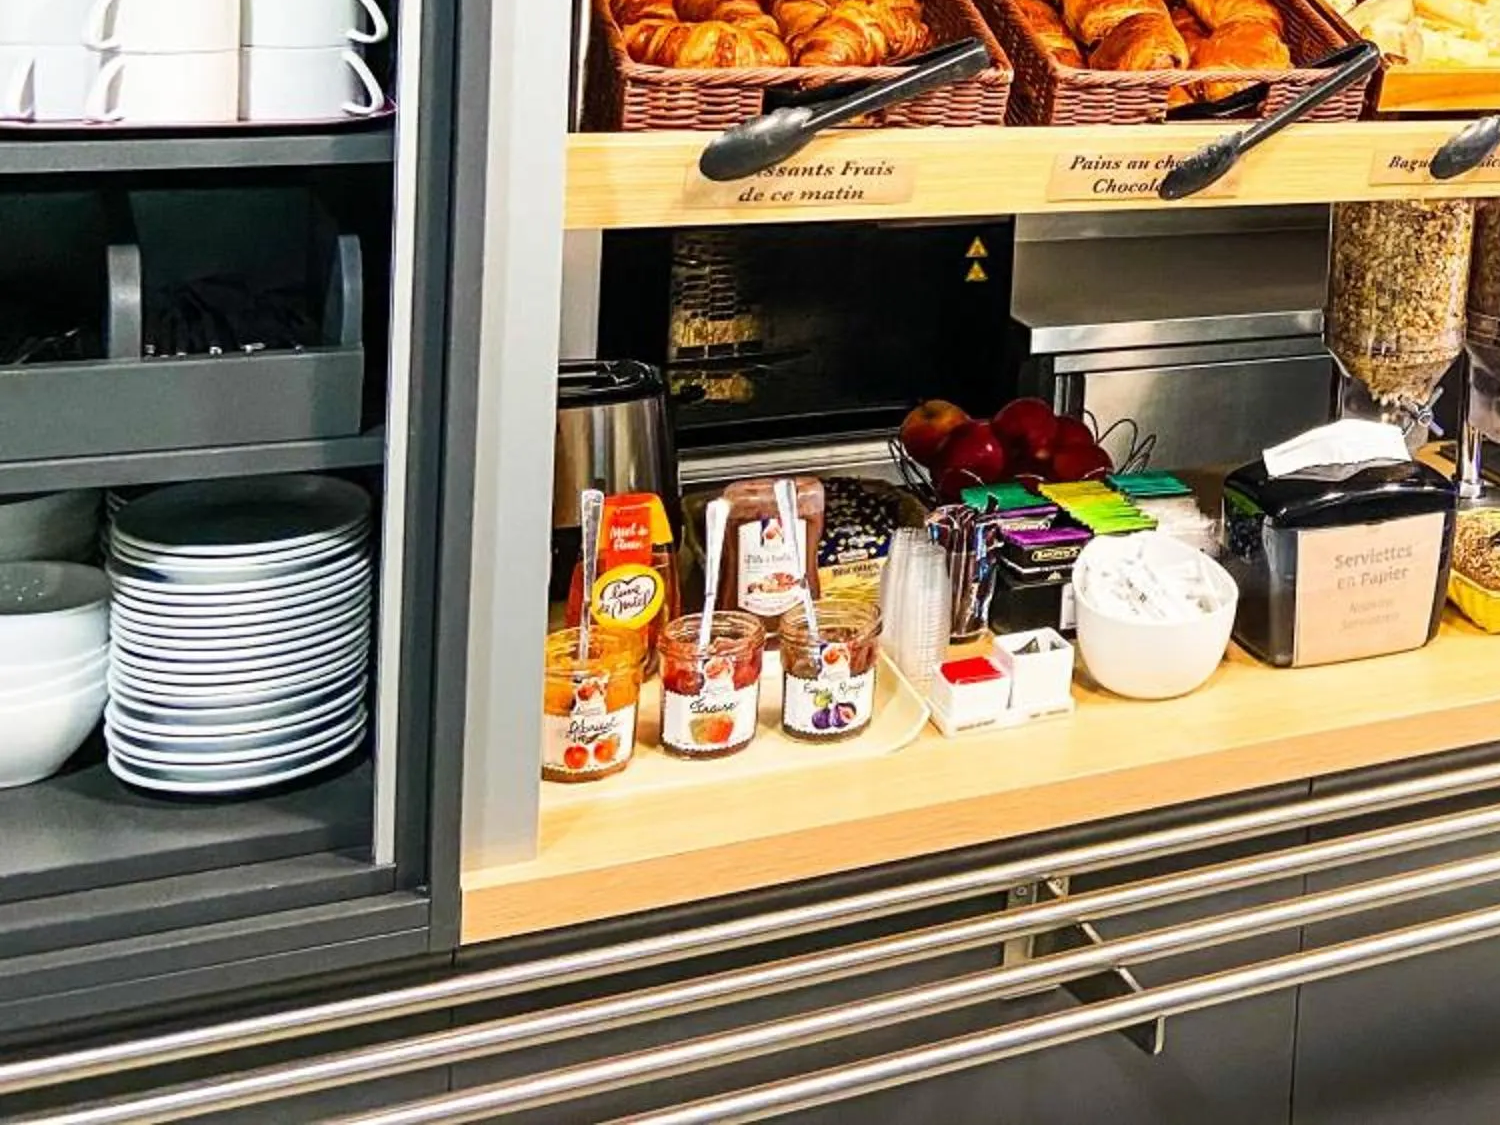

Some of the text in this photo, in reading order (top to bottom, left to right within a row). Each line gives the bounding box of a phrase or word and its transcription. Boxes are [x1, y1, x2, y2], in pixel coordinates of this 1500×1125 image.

[841, 160, 896, 176] Frais
[1069, 155, 1122, 170] Pains
[1127, 160, 1150, 170] au
[738, 185, 866, 202] de ce matin
